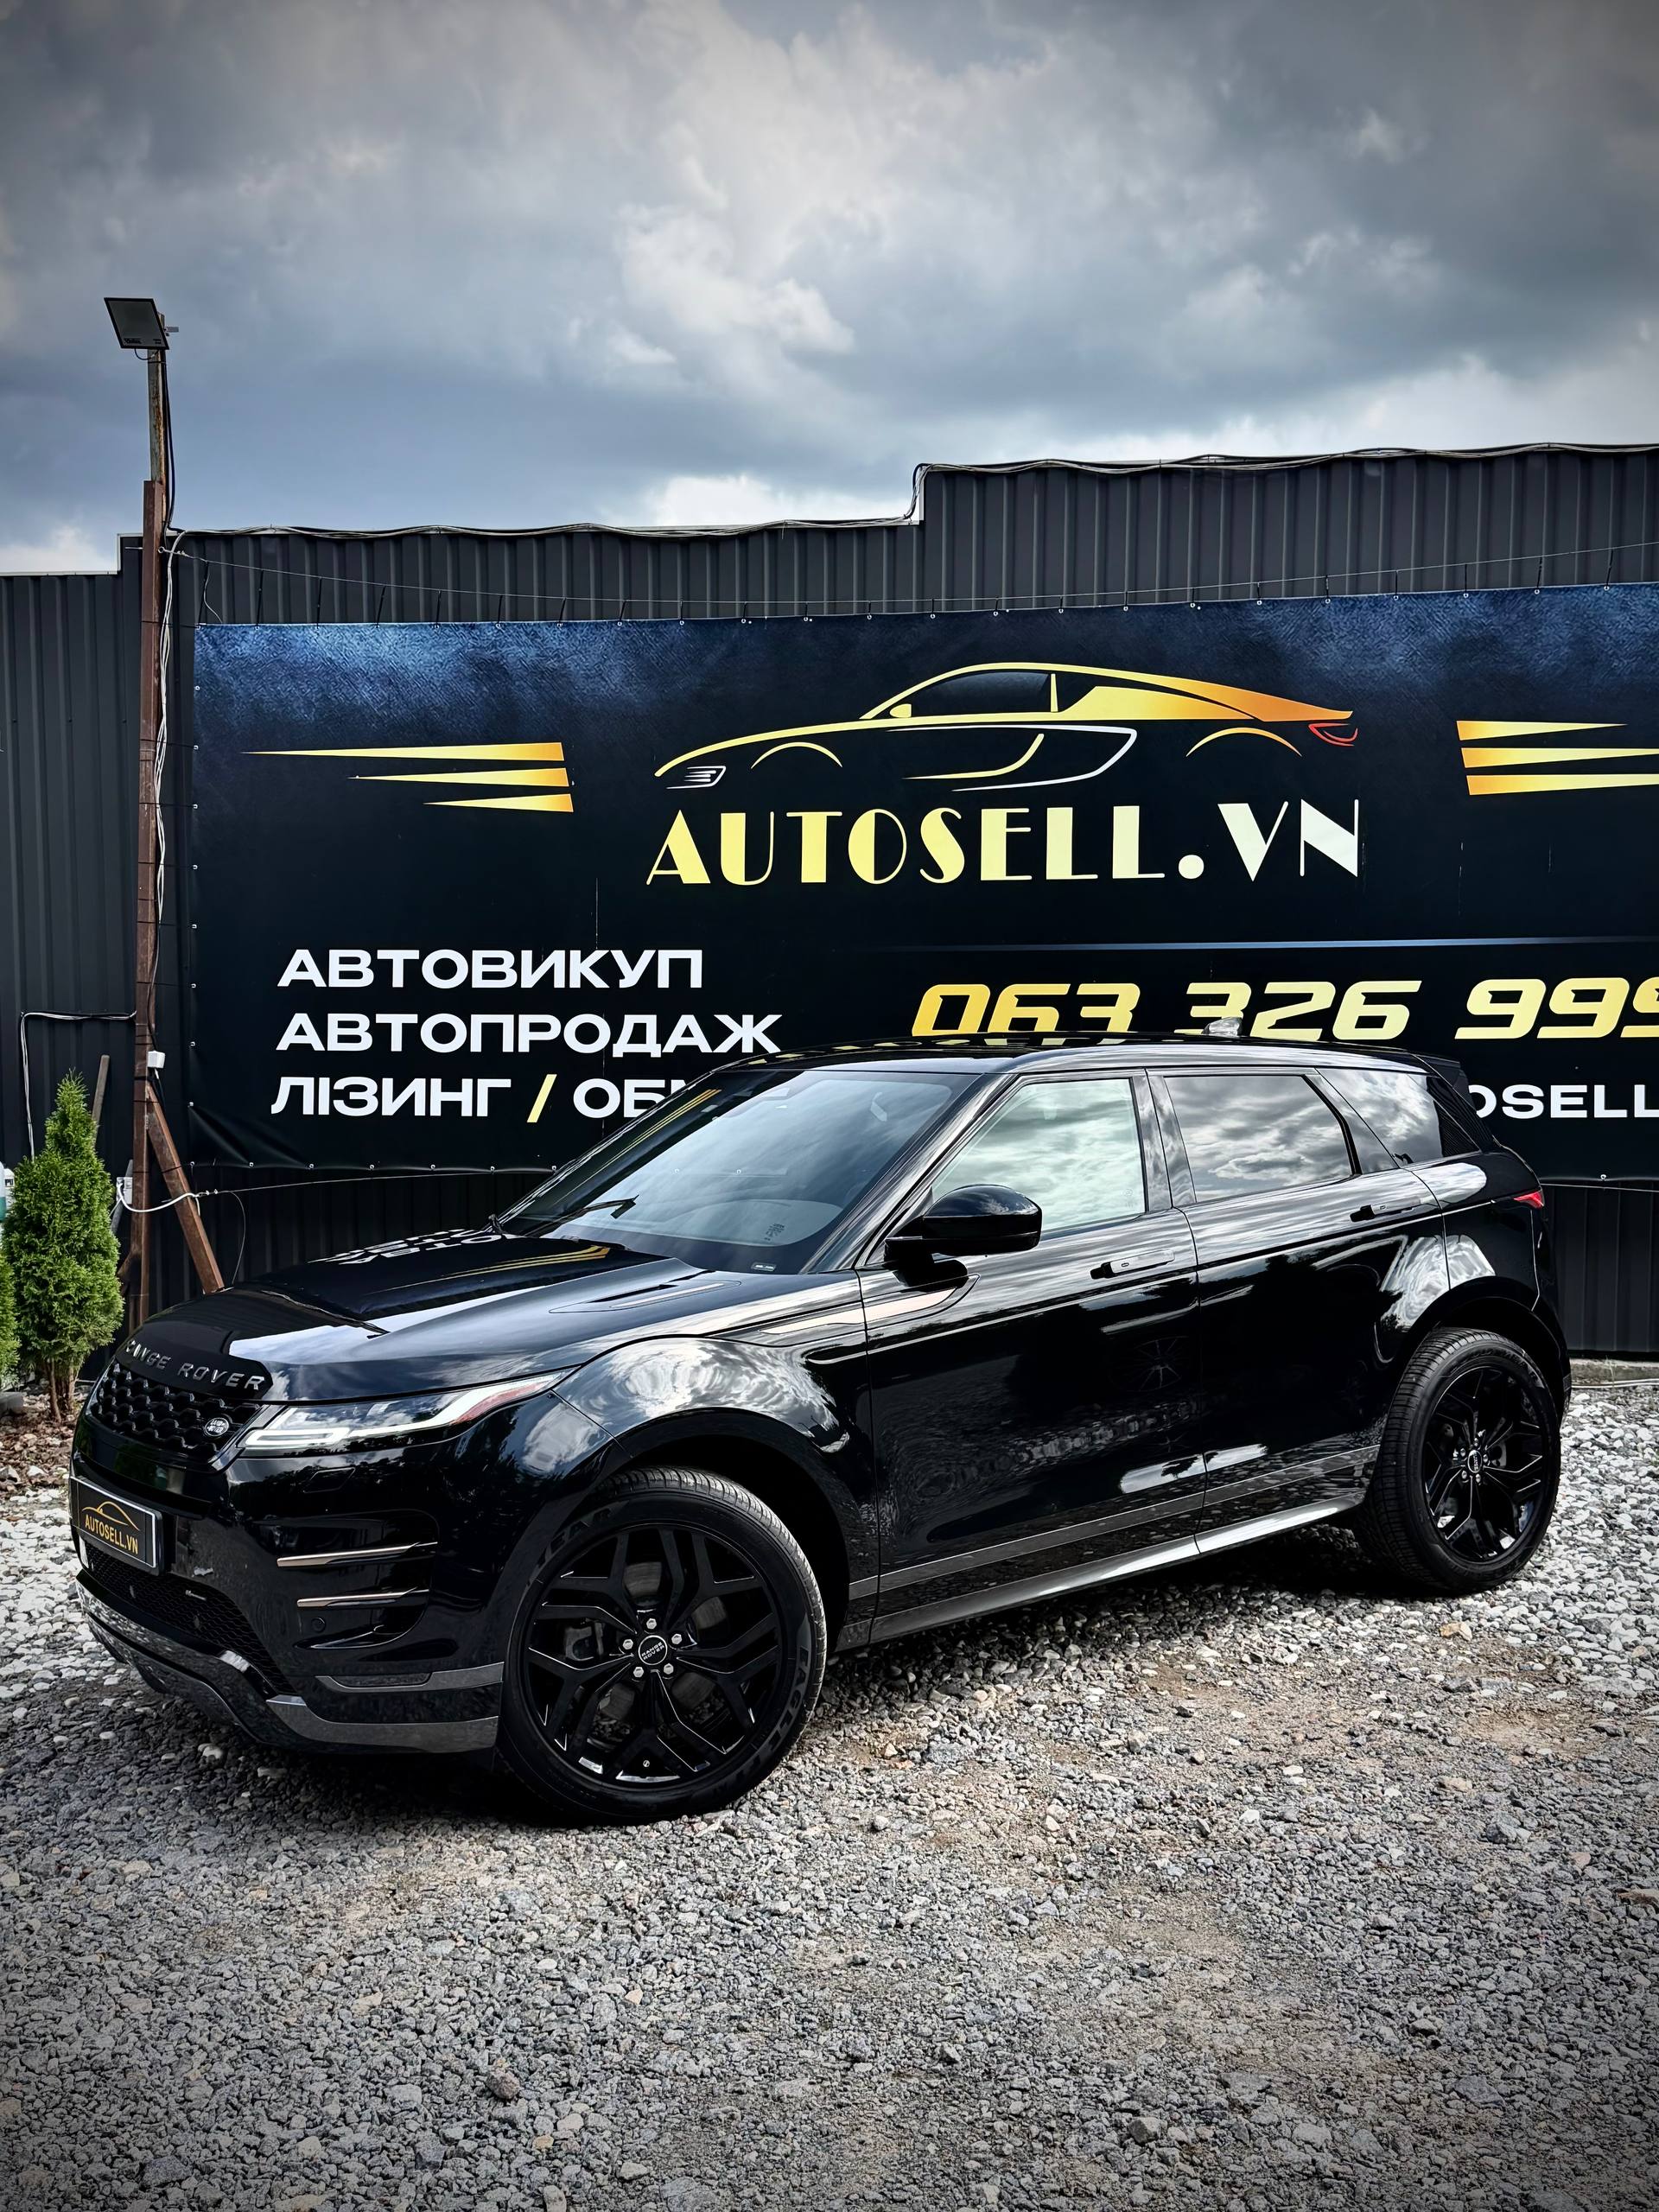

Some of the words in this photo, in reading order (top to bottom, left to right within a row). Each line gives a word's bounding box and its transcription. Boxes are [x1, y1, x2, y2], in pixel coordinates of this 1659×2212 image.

[646, 798, 1360, 887] AUTOSELL.VN
[276, 949, 703, 989] АВТОВИКУП
[912, 982, 1141, 1038] 063
[1173, 980, 1422, 1042] 326
[275, 1013, 783, 1058] АВТОПРОДАЖ
[270, 1077, 512, 1116] ЛІЗИНГ
[573, 1077, 688, 1119] ОБ
[177, 1362, 266, 1391] ROVER
[85, 1513, 139, 1555] AUTOSELL.VN
[641, 1642, 663, 1657] RANGE
[643, 1644, 664, 1661] ROVER
